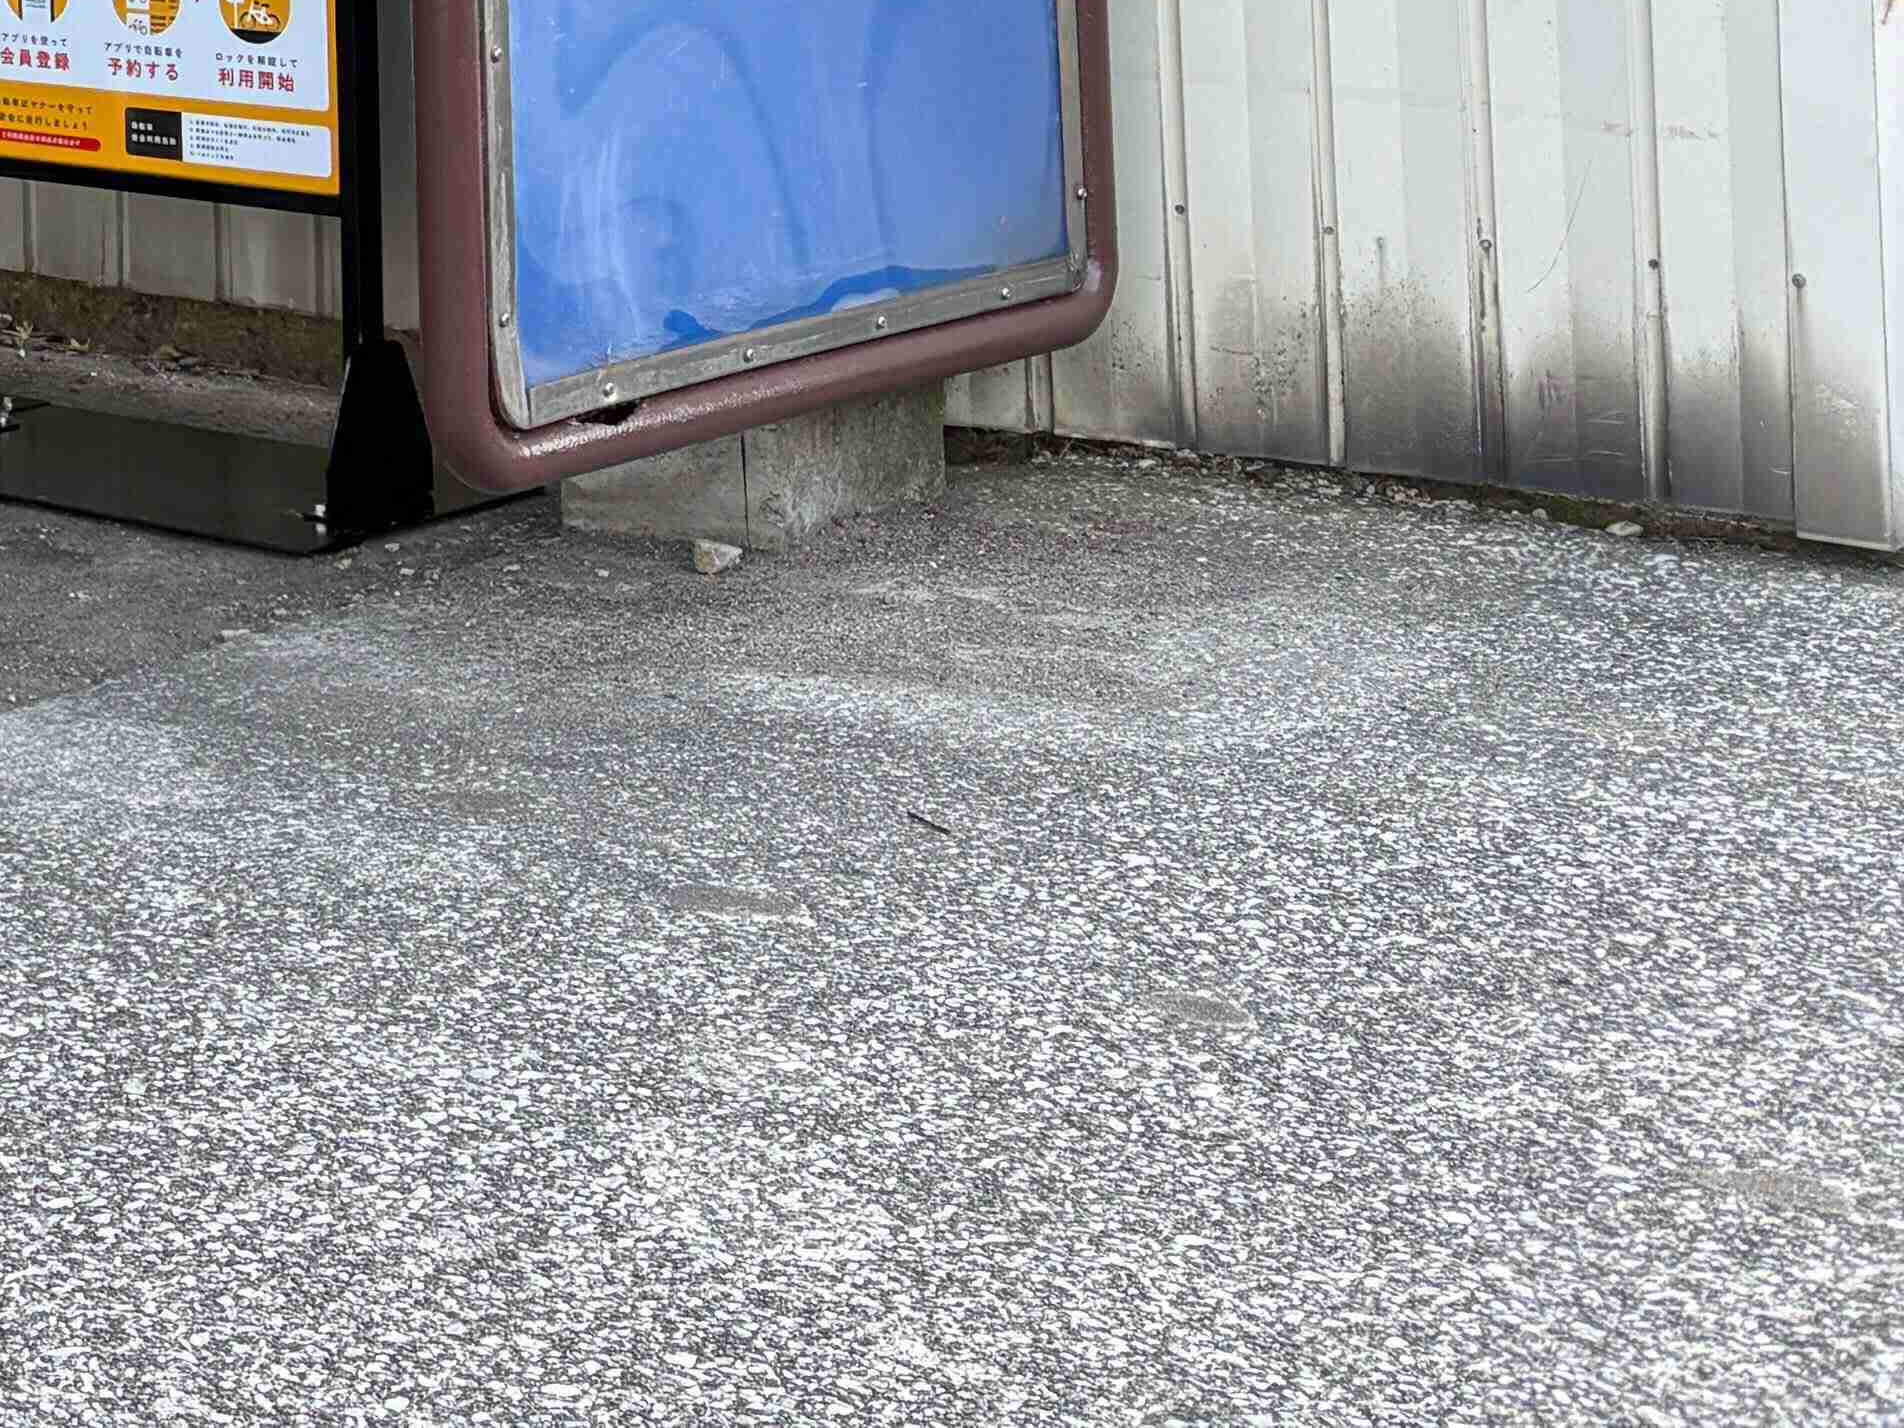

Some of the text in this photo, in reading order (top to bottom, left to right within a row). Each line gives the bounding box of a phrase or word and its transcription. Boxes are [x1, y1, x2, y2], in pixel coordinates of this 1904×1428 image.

[0, 48, 70, 71] 会員登録
[108, 58, 178, 81] 予約する
[218, 68, 294, 92] 利用開始
